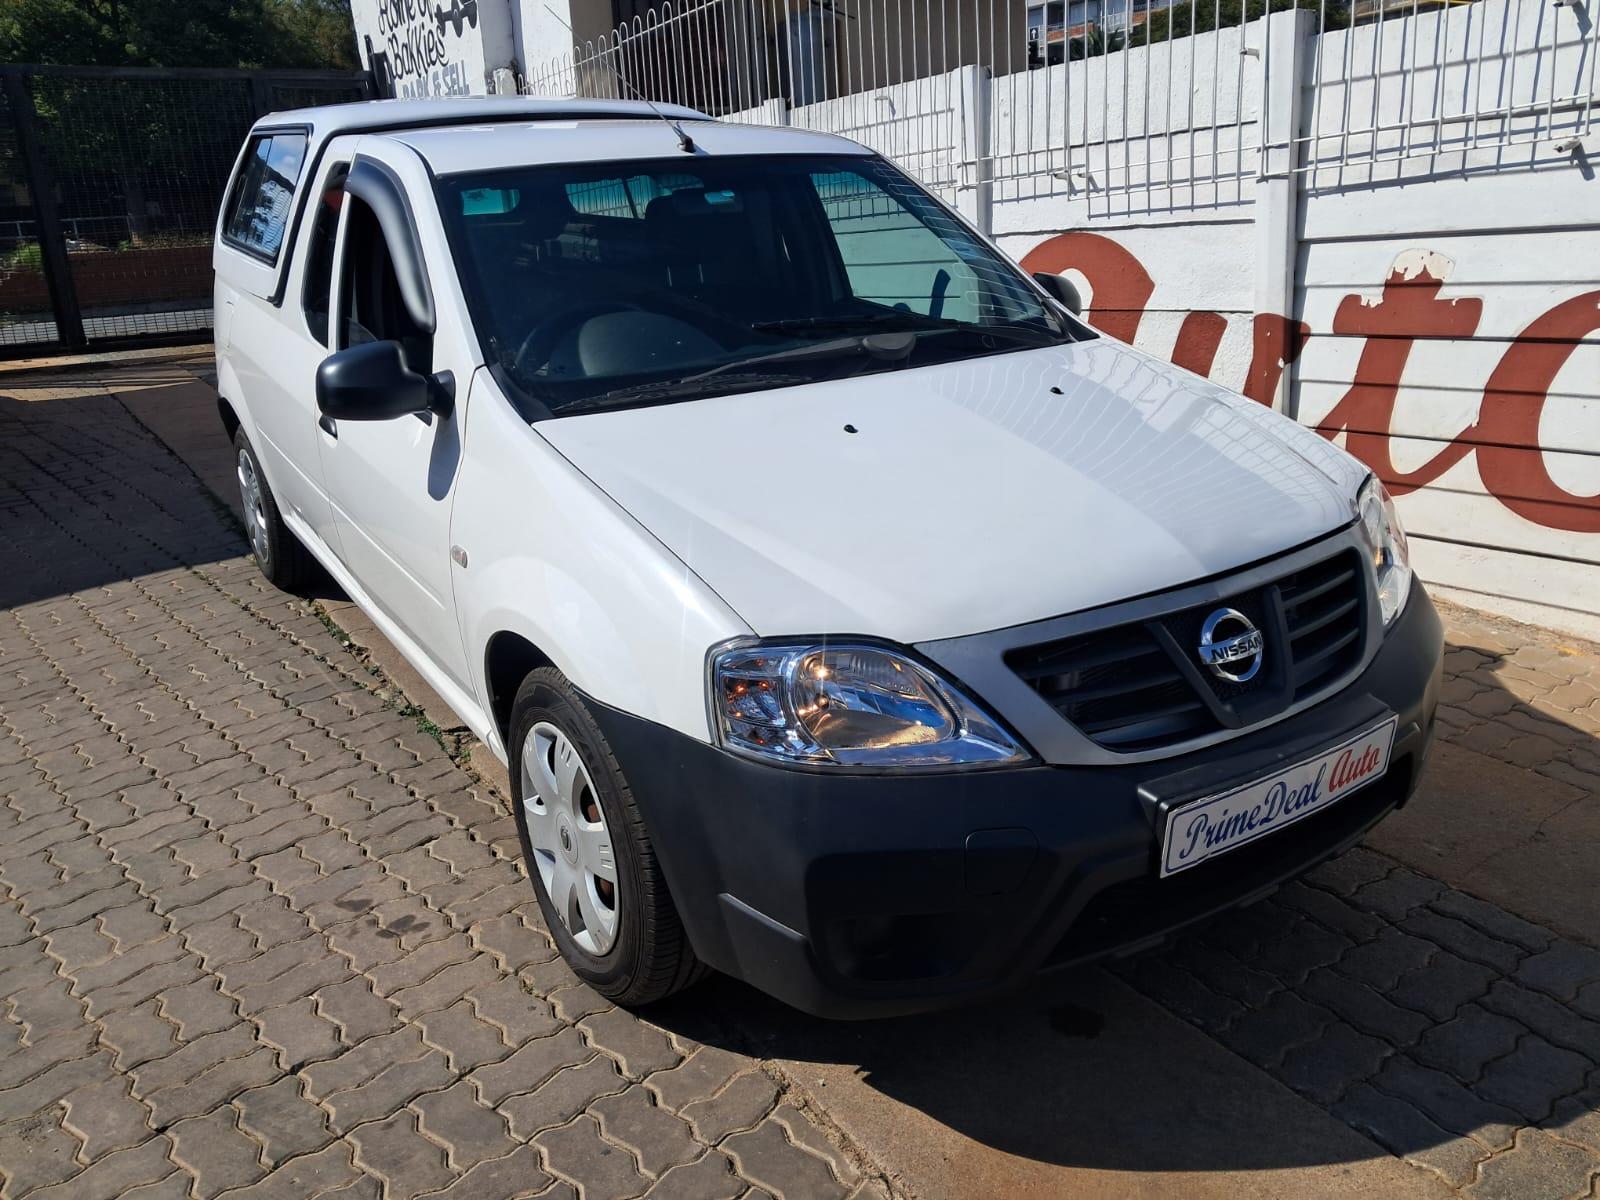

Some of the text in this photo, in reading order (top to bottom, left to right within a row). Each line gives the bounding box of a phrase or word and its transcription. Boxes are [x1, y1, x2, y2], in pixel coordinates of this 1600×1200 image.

[442, 59, 470, 96] SELL
[1210, 635, 1263, 660] NISSAN
[1179, 745, 1380, 860] PrimeDeal Auto
